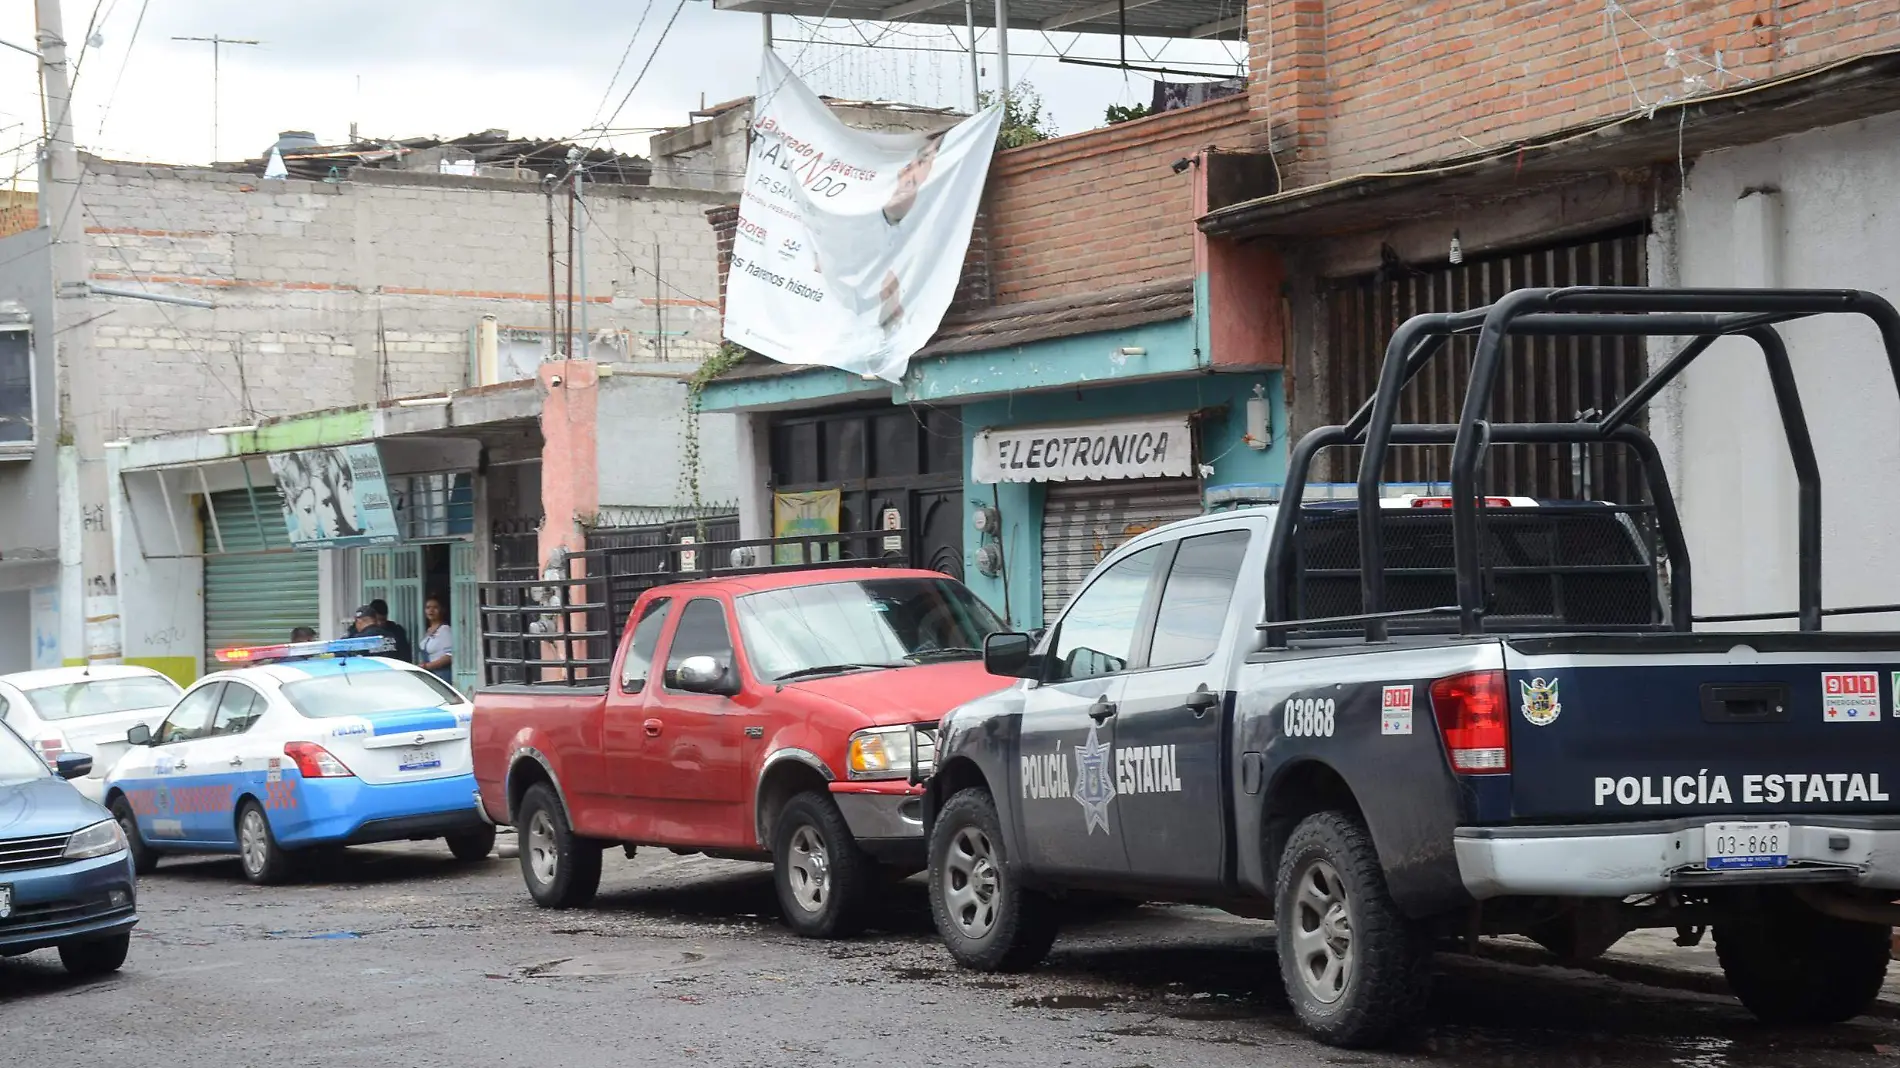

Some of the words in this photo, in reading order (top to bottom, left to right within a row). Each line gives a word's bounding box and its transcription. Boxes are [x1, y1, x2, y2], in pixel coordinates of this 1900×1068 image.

[745, 260, 786, 288] haremos
[784, 277, 824, 303] historia
[998, 431, 1169, 470] ELECTRONICA
[1384, 690, 1410, 707] 911
[1828, 677, 1872, 692] 911
[1283, 698, 1336, 738] 03868
[1021, 739, 1071, 800] POLICÍA
[1115, 744, 1182, 795] ESTATAL
[1594, 768, 1733, 806] POLICÍA
[1742, 773, 1890, 804] ESTATAL
[1717, 835, 1779, 855] 03-868
